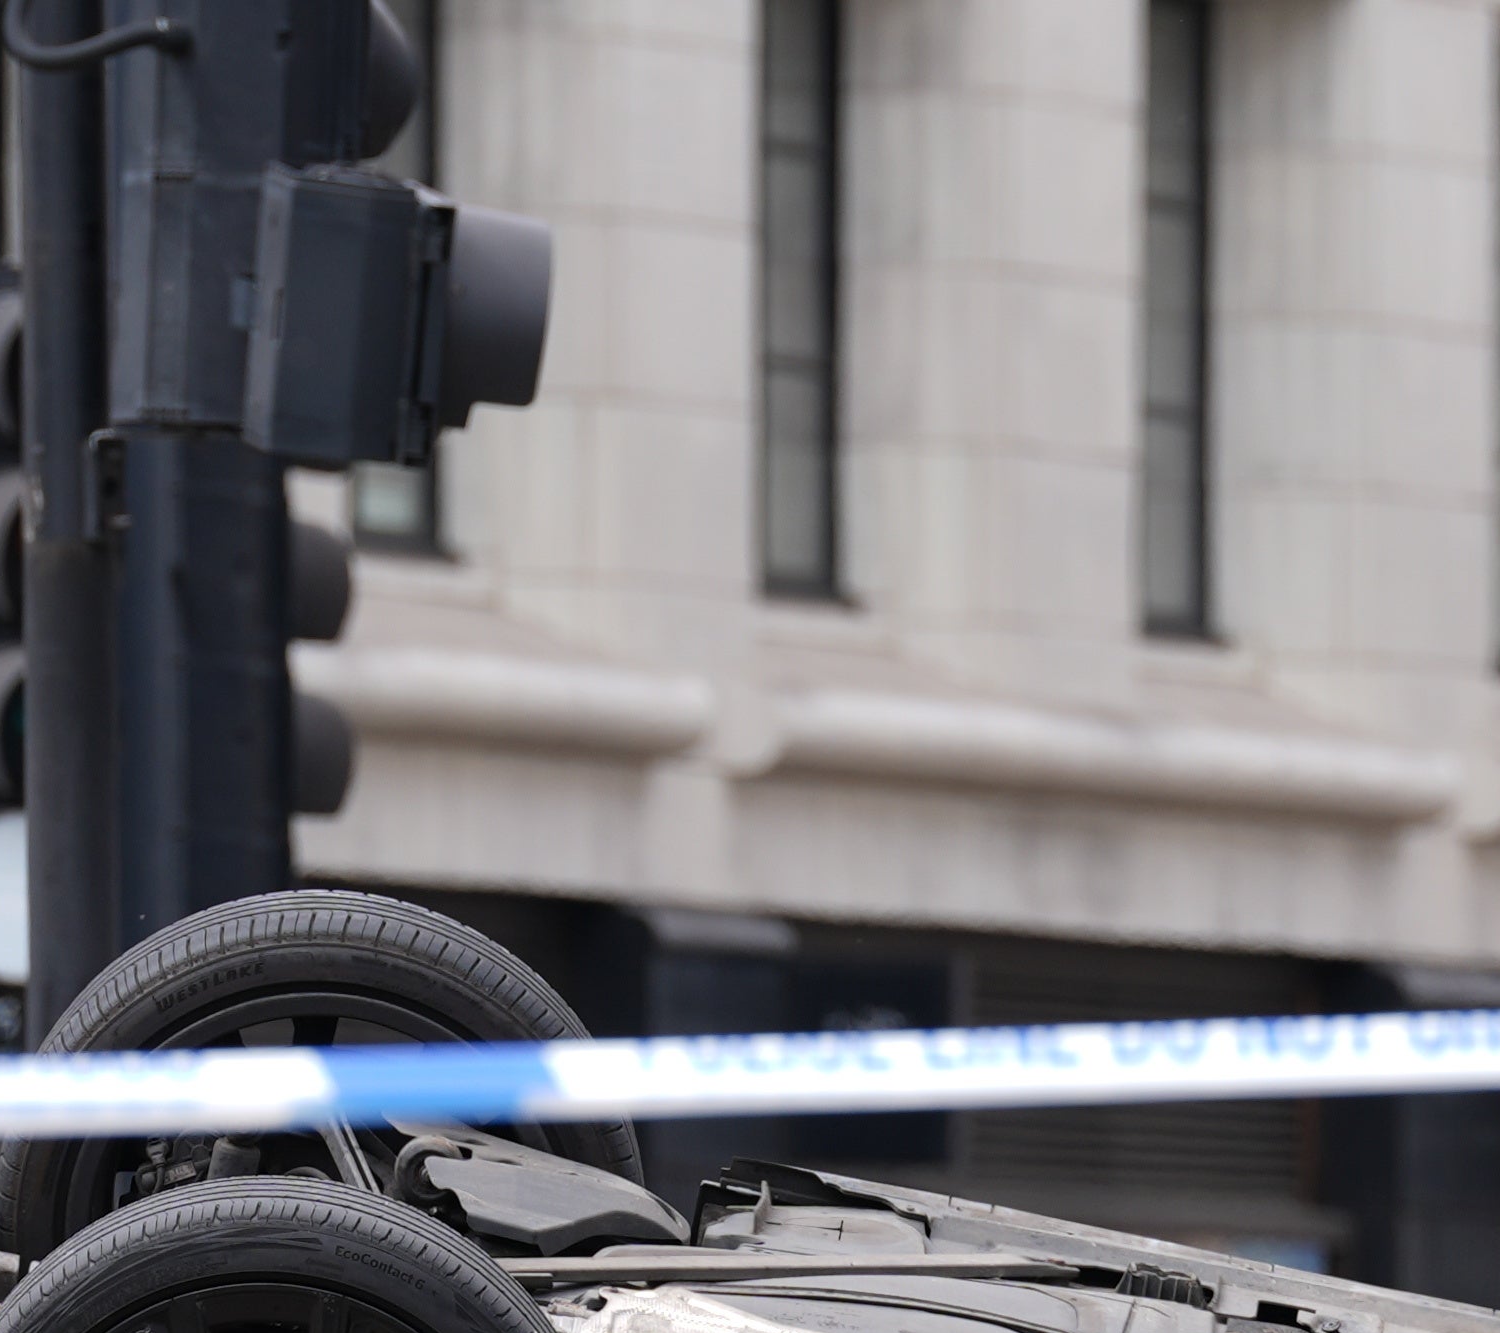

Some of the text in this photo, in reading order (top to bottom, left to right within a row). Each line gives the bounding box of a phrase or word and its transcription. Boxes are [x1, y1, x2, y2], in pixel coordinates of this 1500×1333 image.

[154, 961, 264, 1013] WESTLAKE
[334, 1245, 426, 1290] EcoContact 6
